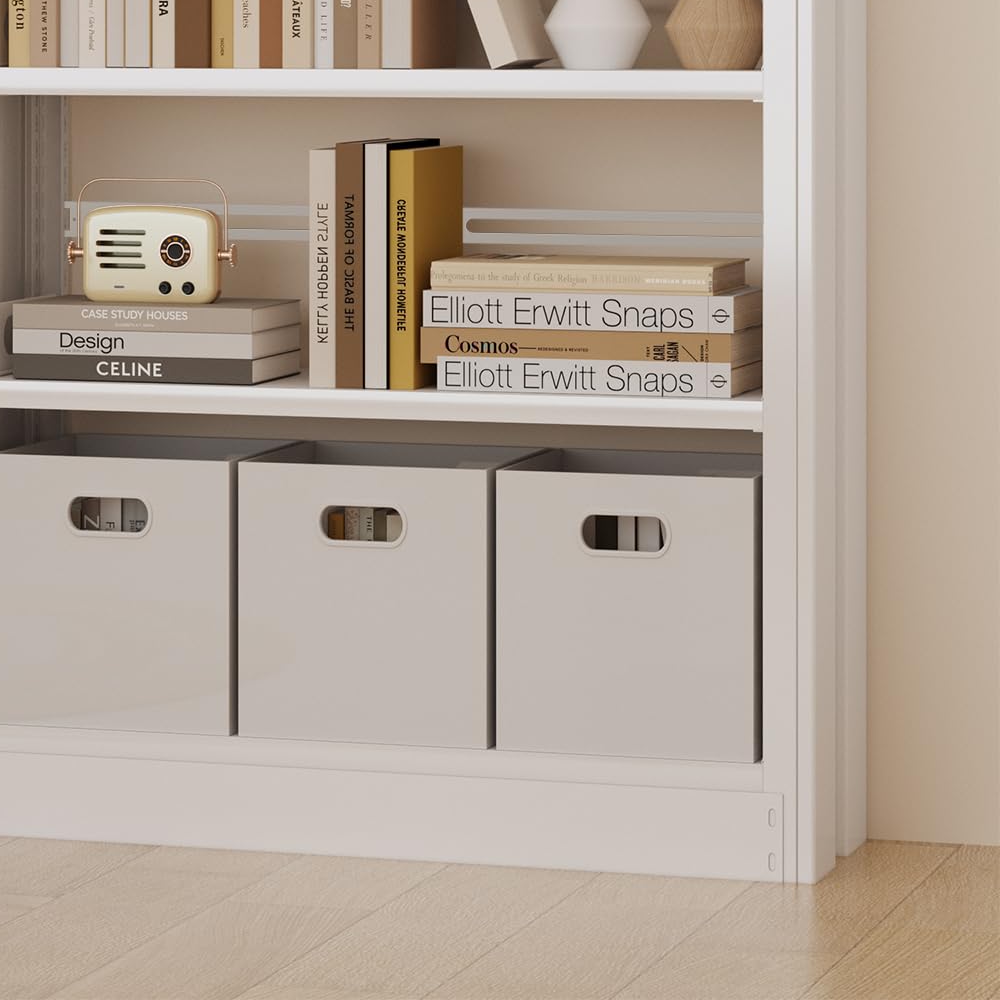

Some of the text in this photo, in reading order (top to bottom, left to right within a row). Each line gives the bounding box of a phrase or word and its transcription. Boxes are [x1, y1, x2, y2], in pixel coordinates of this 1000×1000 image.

[488, 272, 499, 280] the
[502, 272, 519, 282] study
[521, 272, 531, 281] of
[534, 273, 554, 281] Greek
[81, 309, 188, 320] CASE STUDY HOUSES
[431, 296, 694, 332] Elliott Erwitt Snaps
[60, 332, 124, 354] Design
[445, 334, 518, 354] Cosmos
[654, 344, 665, 360] CARL
[96, 362, 162, 377] CELINE
[445, 361, 694, 396] Elliott Erwitt Snaps
